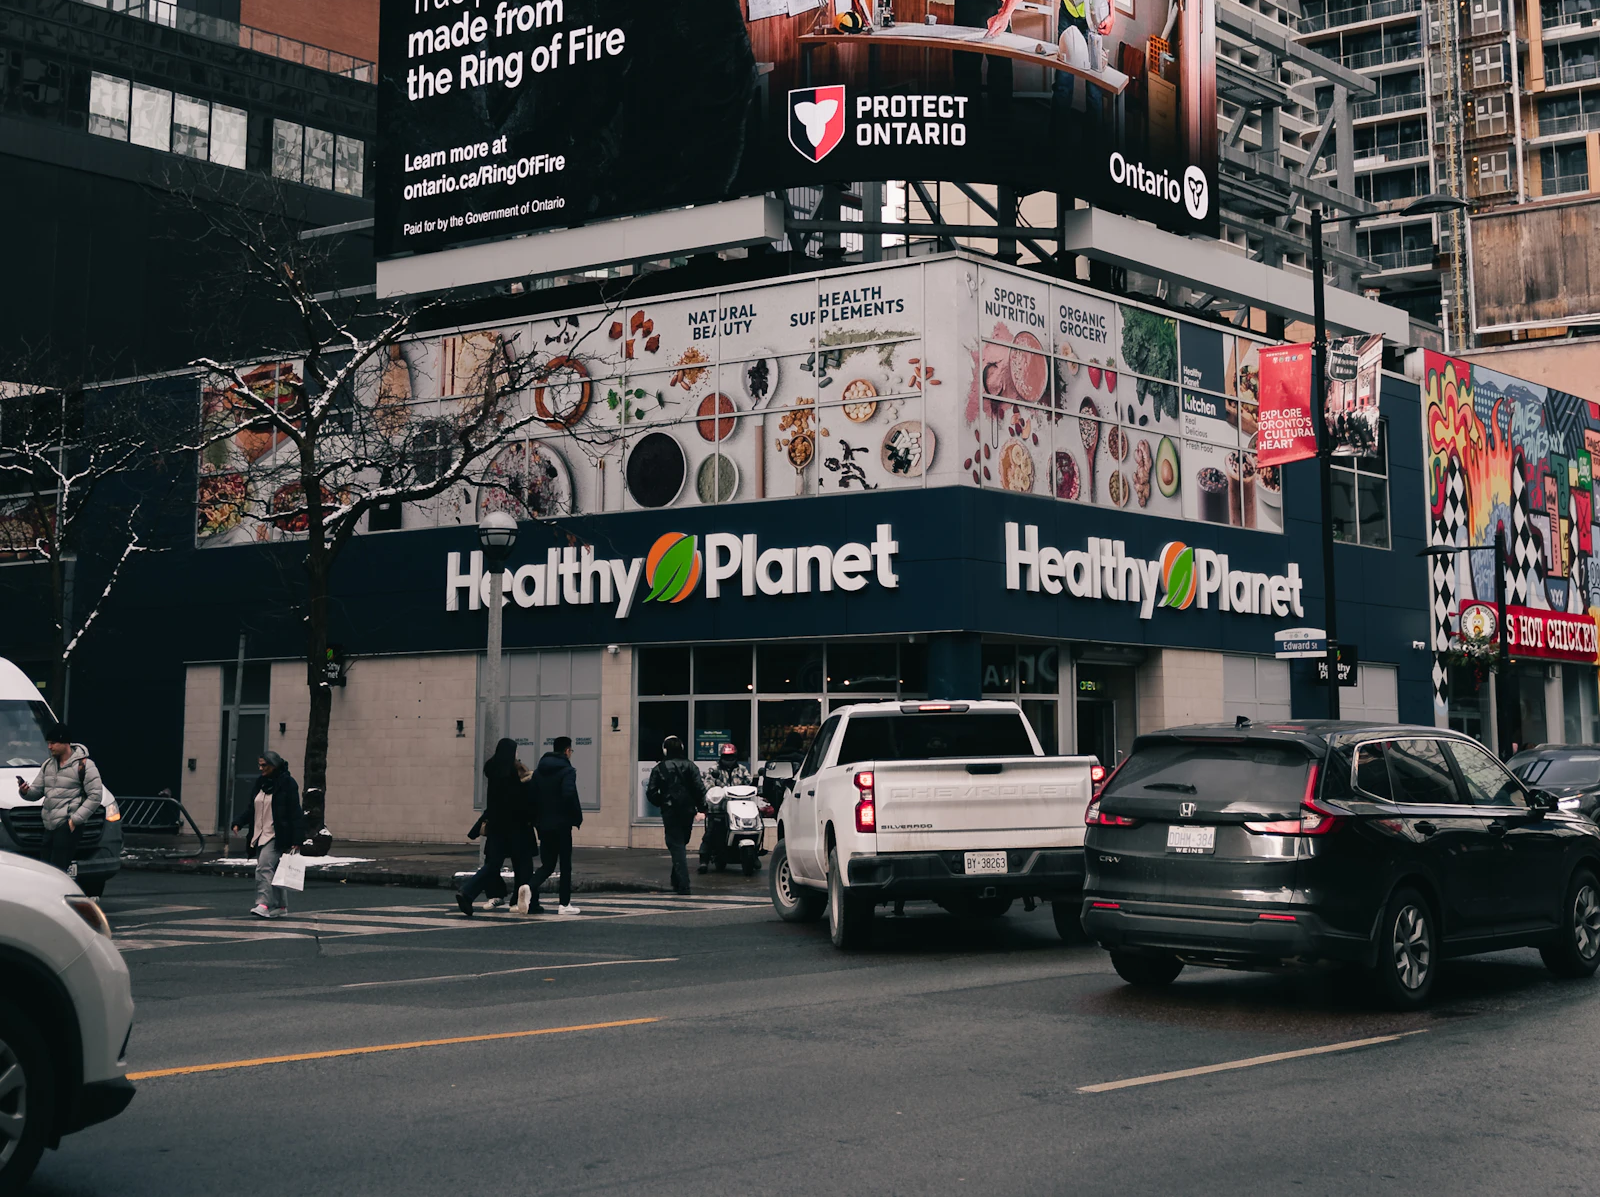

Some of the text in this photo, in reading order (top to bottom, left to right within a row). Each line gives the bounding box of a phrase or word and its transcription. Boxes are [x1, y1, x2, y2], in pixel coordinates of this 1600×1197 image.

[407, 11, 487, 59] made
[406, 24, 626, 102] the Ring of Fire
[855, 94, 969, 120] PROTECT
[855, 122, 967, 148] ONTARIO
[404, 134, 507, 173] Learn more at
[403, 152, 566, 201] ontario.ca/RingOfFire
[1108, 151, 1182, 204] Ontario
[403, 196, 565, 236] Paid for by the Government of Ontario
[818, 285, 882, 308] HEALTH
[993, 286, 1037, 310] SPORTS
[688, 303, 757, 326] NATURAL
[789, 298, 905, 328] SUPPLEMENTS
[985, 299, 1046, 329] NUTRITION
[1059, 304, 1106, 330] ORGANIC
[1059, 320, 1109, 345] GROCERY
[1183, 365, 1203, 381] Healthy
[1183, 375, 1200, 388] Planet
[1185, 414, 1197, 426] Real
[1260, 407, 1303, 421] EXPLORE
[1185, 425, 1208, 439] Delicious
[1259, 438, 1294, 450] HEART
[1264, 426, 1316, 440] CULTURAL
[1201, 442, 1214, 454] Food
[705, 524, 899, 599] Planet
[1005, 521, 1304, 619] Healthy Planet
[1283, 641, 1318, 651] Edward St
[1519, 615, 1544, 648] HOT
[1547, 619, 1598, 653] CHICKEN
[1318, 662, 1351, 674] Hethy
[1320, 670, 1348, 680] Plet
[1099, 855, 1121, 863] CR-V
